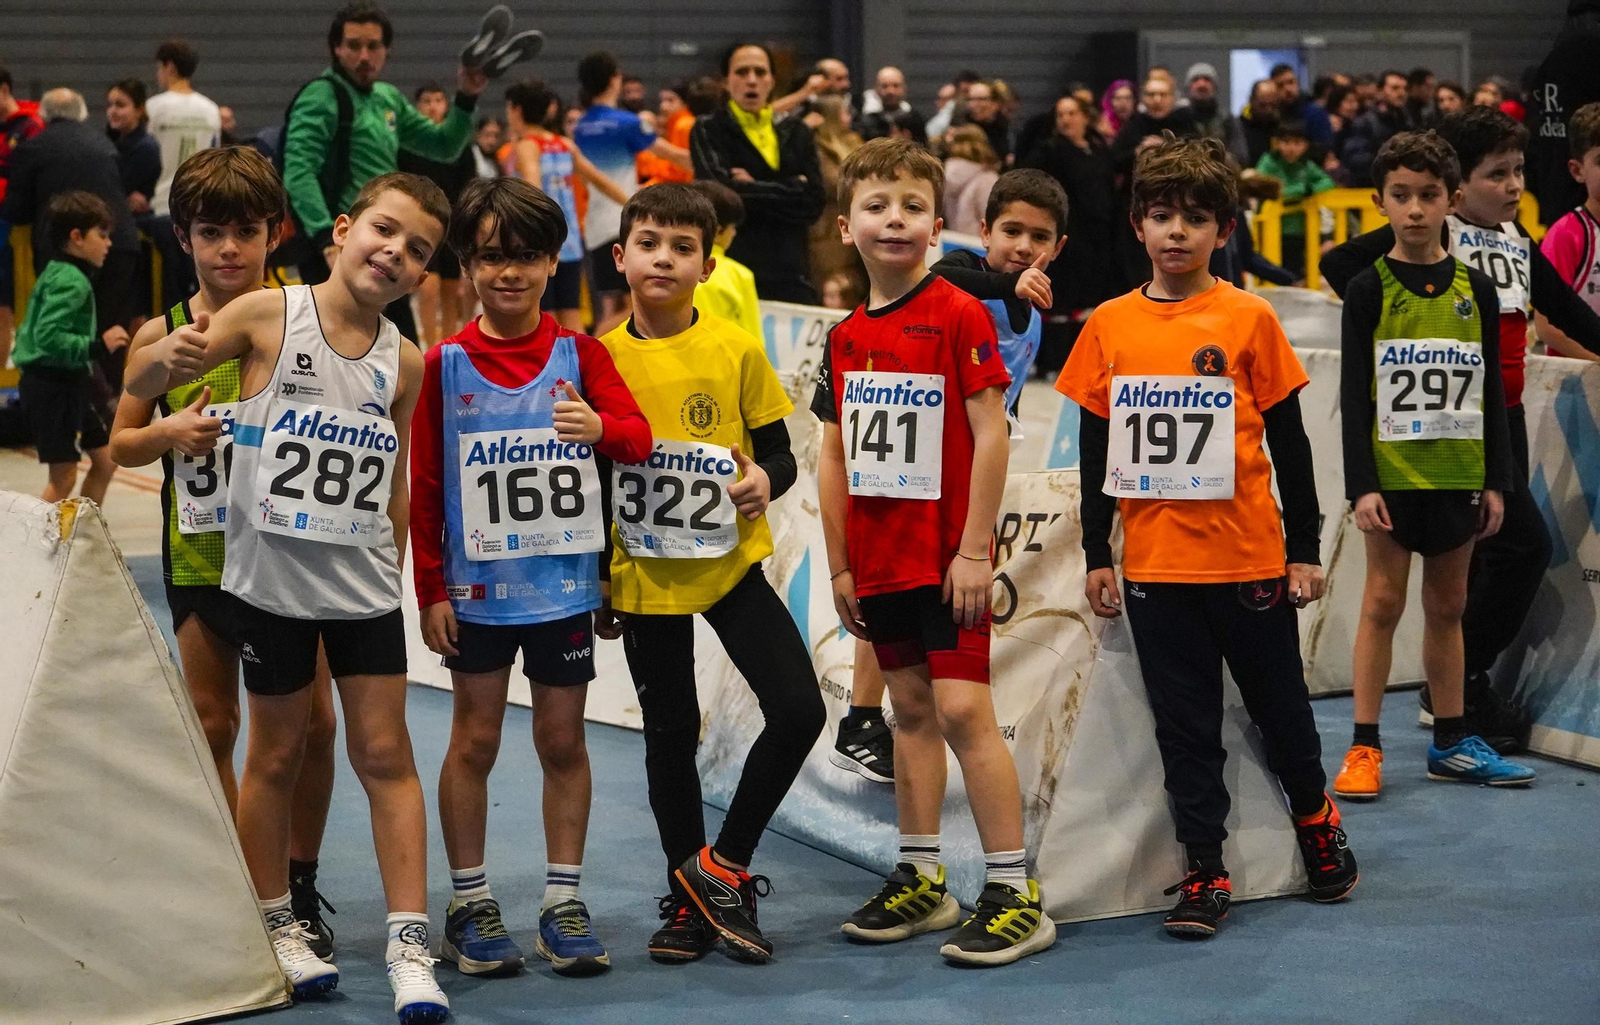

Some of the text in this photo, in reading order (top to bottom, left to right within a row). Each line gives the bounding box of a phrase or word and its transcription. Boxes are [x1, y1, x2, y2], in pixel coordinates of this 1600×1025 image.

[1470, 250, 1529, 293] 106
[1379, 343, 1482, 366] Atlántico
[844, 377, 943, 407] Atlántico
[1114, 381, 1233, 409] Atlántico
[1390, 368, 1474, 412] 297
[272, 408, 398, 454] Atlántico
[849, 409, 917, 463] 141
[1125, 412, 1214, 465] 197
[465, 435, 592, 467] Atlántico
[618, 443, 735, 476] ántico
[270, 440, 385, 513] 282
[861, 473, 880, 481] XUNTA
[868, 480, 894, 488] GALICIA
[1161, 483, 1187, 491] GALICIA
[477, 465, 585, 524] 168
[618, 472, 721, 531] 322
[308, 523, 346, 535] DE GALICIA
[310, 516, 334, 526] XUNTA
[521, 533, 545, 541] XUNTA
[521, 538, 560, 549] DE GALICIA
[654, 536, 677, 544] XUNTA
[664, 543, 692, 551] GALICIA
[509, 588, 551, 598] DE GALICIA
[563, 646, 591, 662] vive
